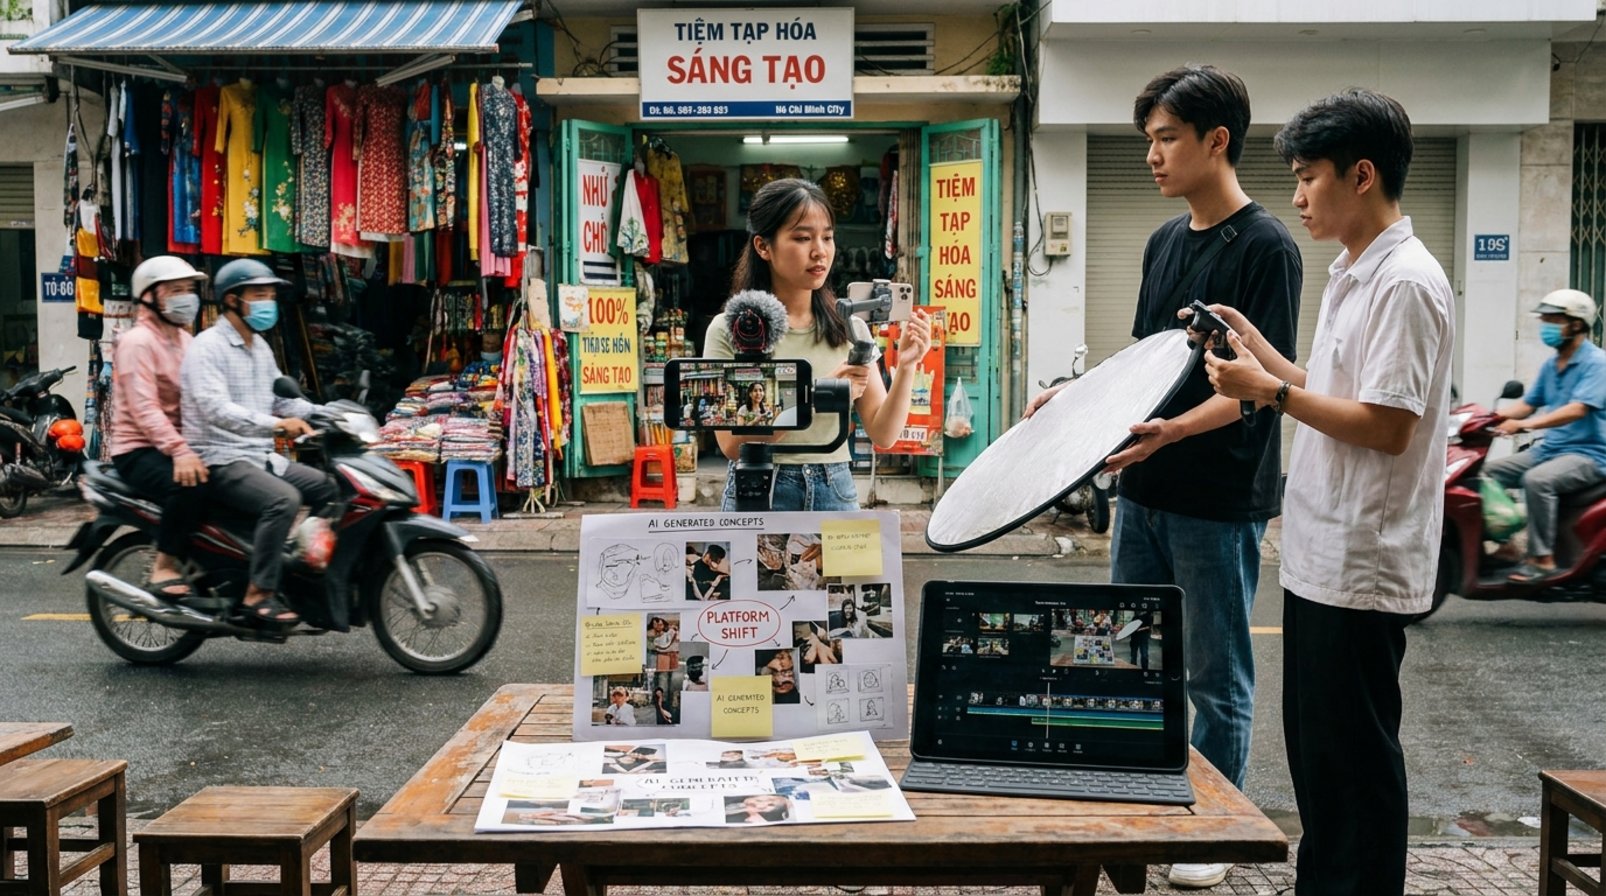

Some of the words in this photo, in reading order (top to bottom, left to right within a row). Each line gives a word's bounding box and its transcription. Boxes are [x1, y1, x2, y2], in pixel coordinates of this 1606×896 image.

[674, 17, 724, 45] TIỆM
[730, 22, 769, 45] TẠP
[775, 17, 817, 41] HÓA
[666, 47, 752, 85] SÁNG
[762, 54, 826, 90] TẠO
[936, 173, 976, 203] TIỆM
[940, 211, 971, 236] TẠP
[939, 239, 971, 265] HÓA
[934, 273, 977, 299] SÁNG
[587, 297, 629, 325] 100%
[648, 519, 658, 528] AI
[664, 519, 715, 528] GENERATED
[719, 517, 764, 527] CONCEPTS
[707, 611, 770, 624] PLATFORM
[721, 627, 758, 639] SHIFT
